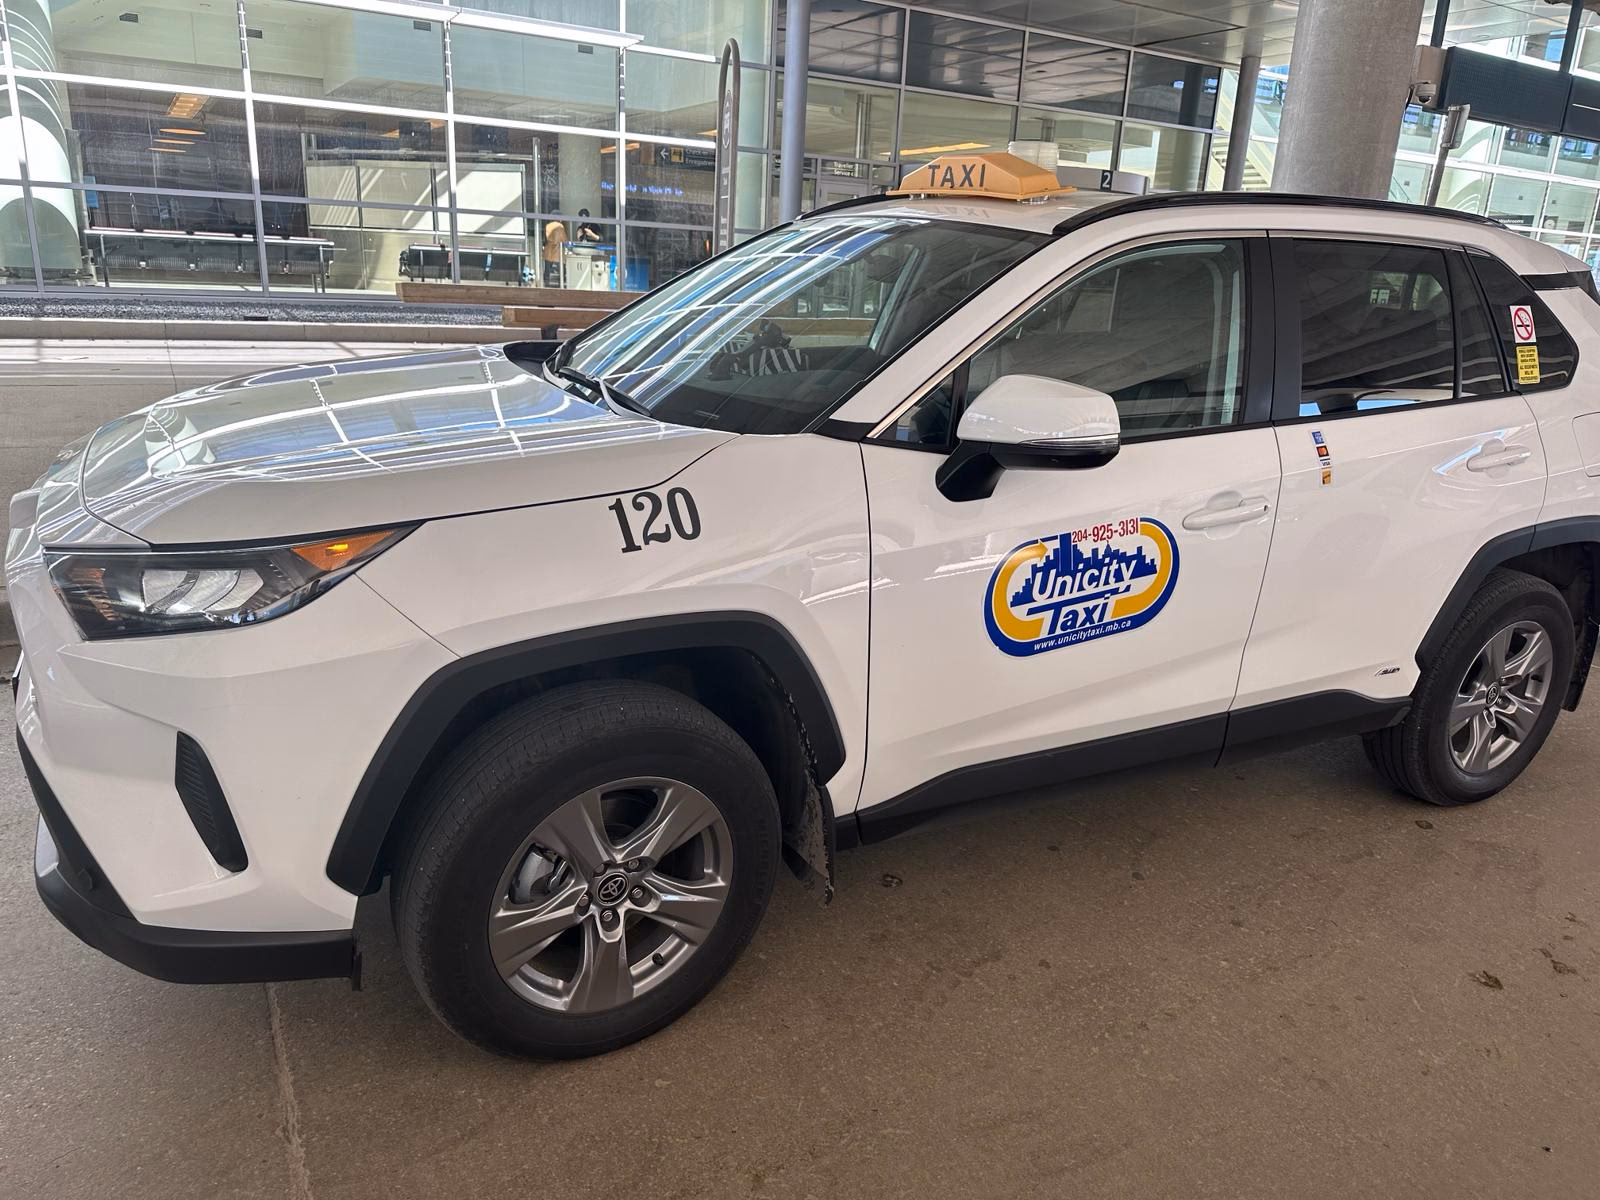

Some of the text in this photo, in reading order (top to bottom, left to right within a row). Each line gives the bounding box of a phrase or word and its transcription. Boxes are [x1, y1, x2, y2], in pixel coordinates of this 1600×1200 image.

[928, 163, 986, 188] TAXI
[1102, 172, 1111, 188] 2
[608, 486, 701, 554] 120
[1072, 517, 1139, 544] 204-925-3131
[1032, 557, 1137, 603] Unicity
[1028, 594, 1112, 636] Taxi
[1033, 619, 1132, 651] www.unicitytaxi.mb.ca
